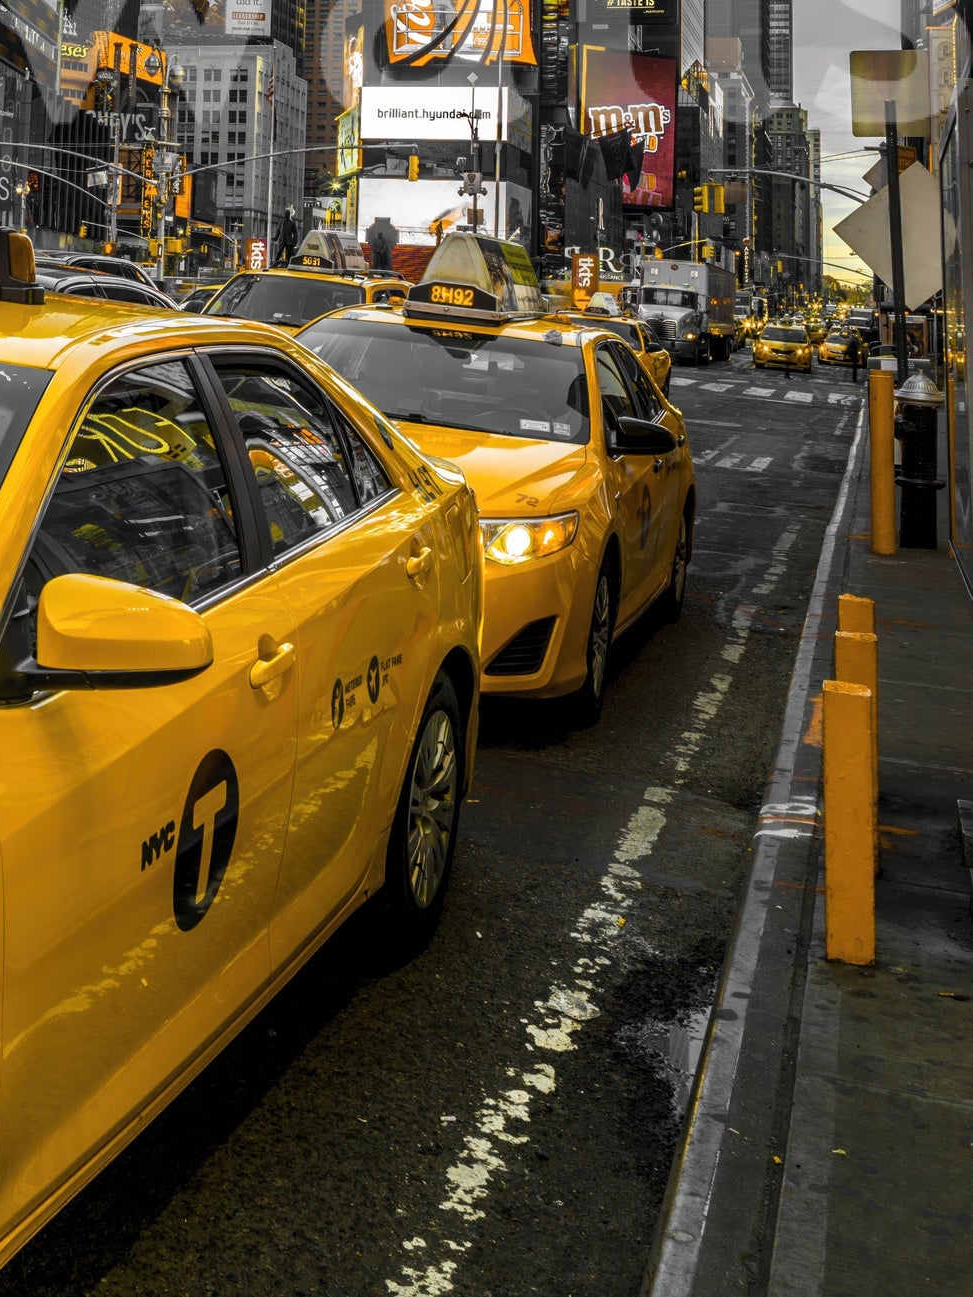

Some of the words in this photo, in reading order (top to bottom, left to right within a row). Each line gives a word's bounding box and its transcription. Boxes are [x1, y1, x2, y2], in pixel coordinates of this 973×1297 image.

[232, 12, 265, 21] LEADERSHIP
[377, 108, 491, 121] brilliant.hyundai.cm
[250, 241, 266, 270] tkts
[578, 256, 594, 288] tkts
[431, 285, 474, 307] 8H92
[515, 493, 540, 507] 72
[141, 820, 175, 871] NYC
